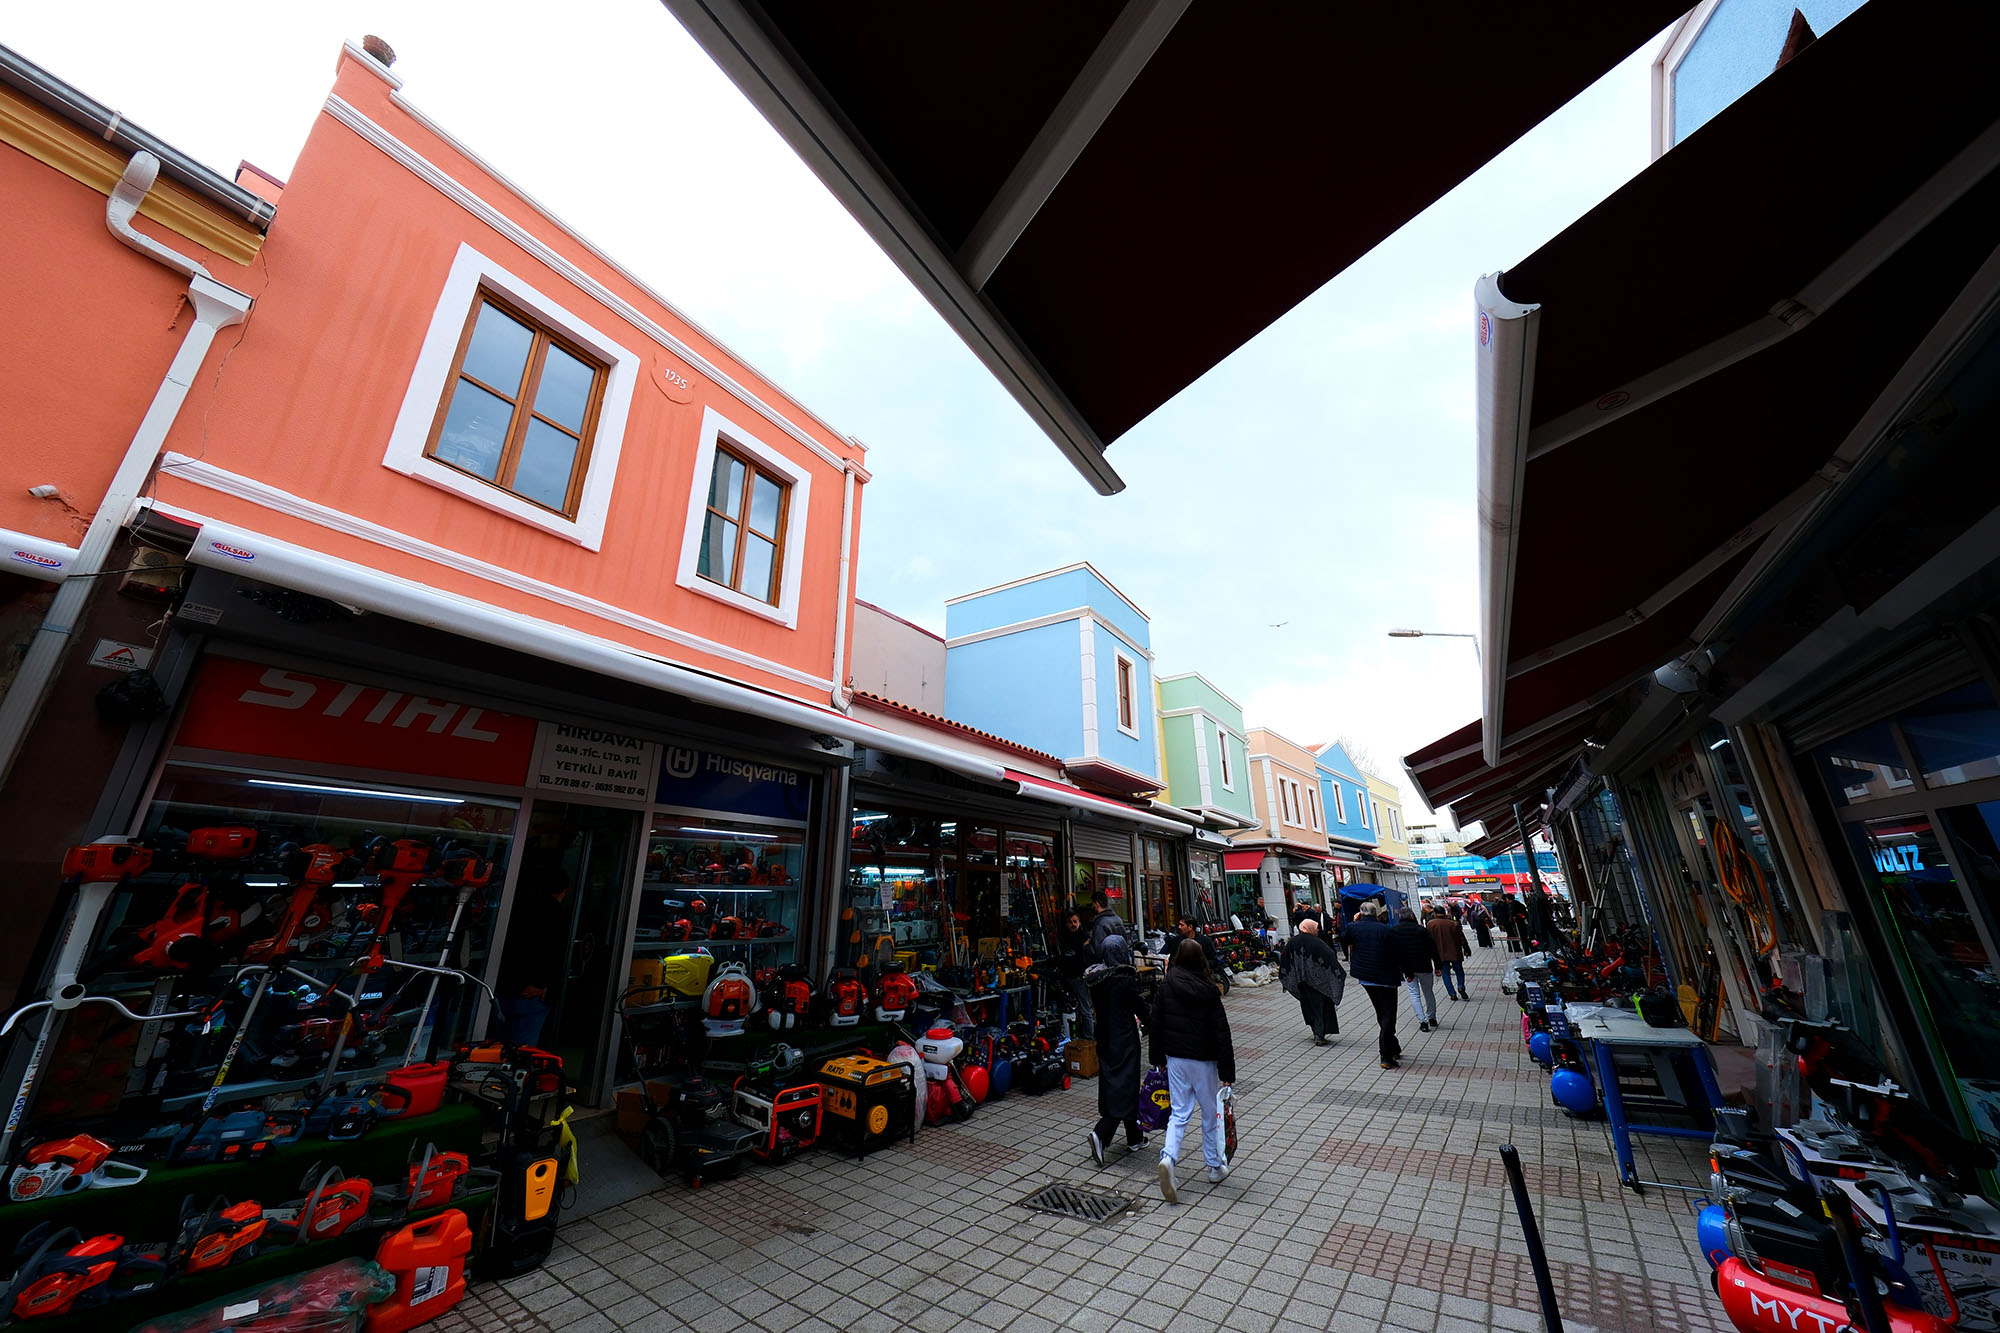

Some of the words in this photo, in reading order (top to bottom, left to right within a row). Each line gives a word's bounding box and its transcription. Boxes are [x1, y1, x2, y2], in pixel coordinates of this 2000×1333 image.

[237, 667, 501, 743] STIHL
[555, 743, 578, 755] SAN
[705, 752, 798, 787] Husqvarna
[1962, 1253, 1992, 1266] SAW
